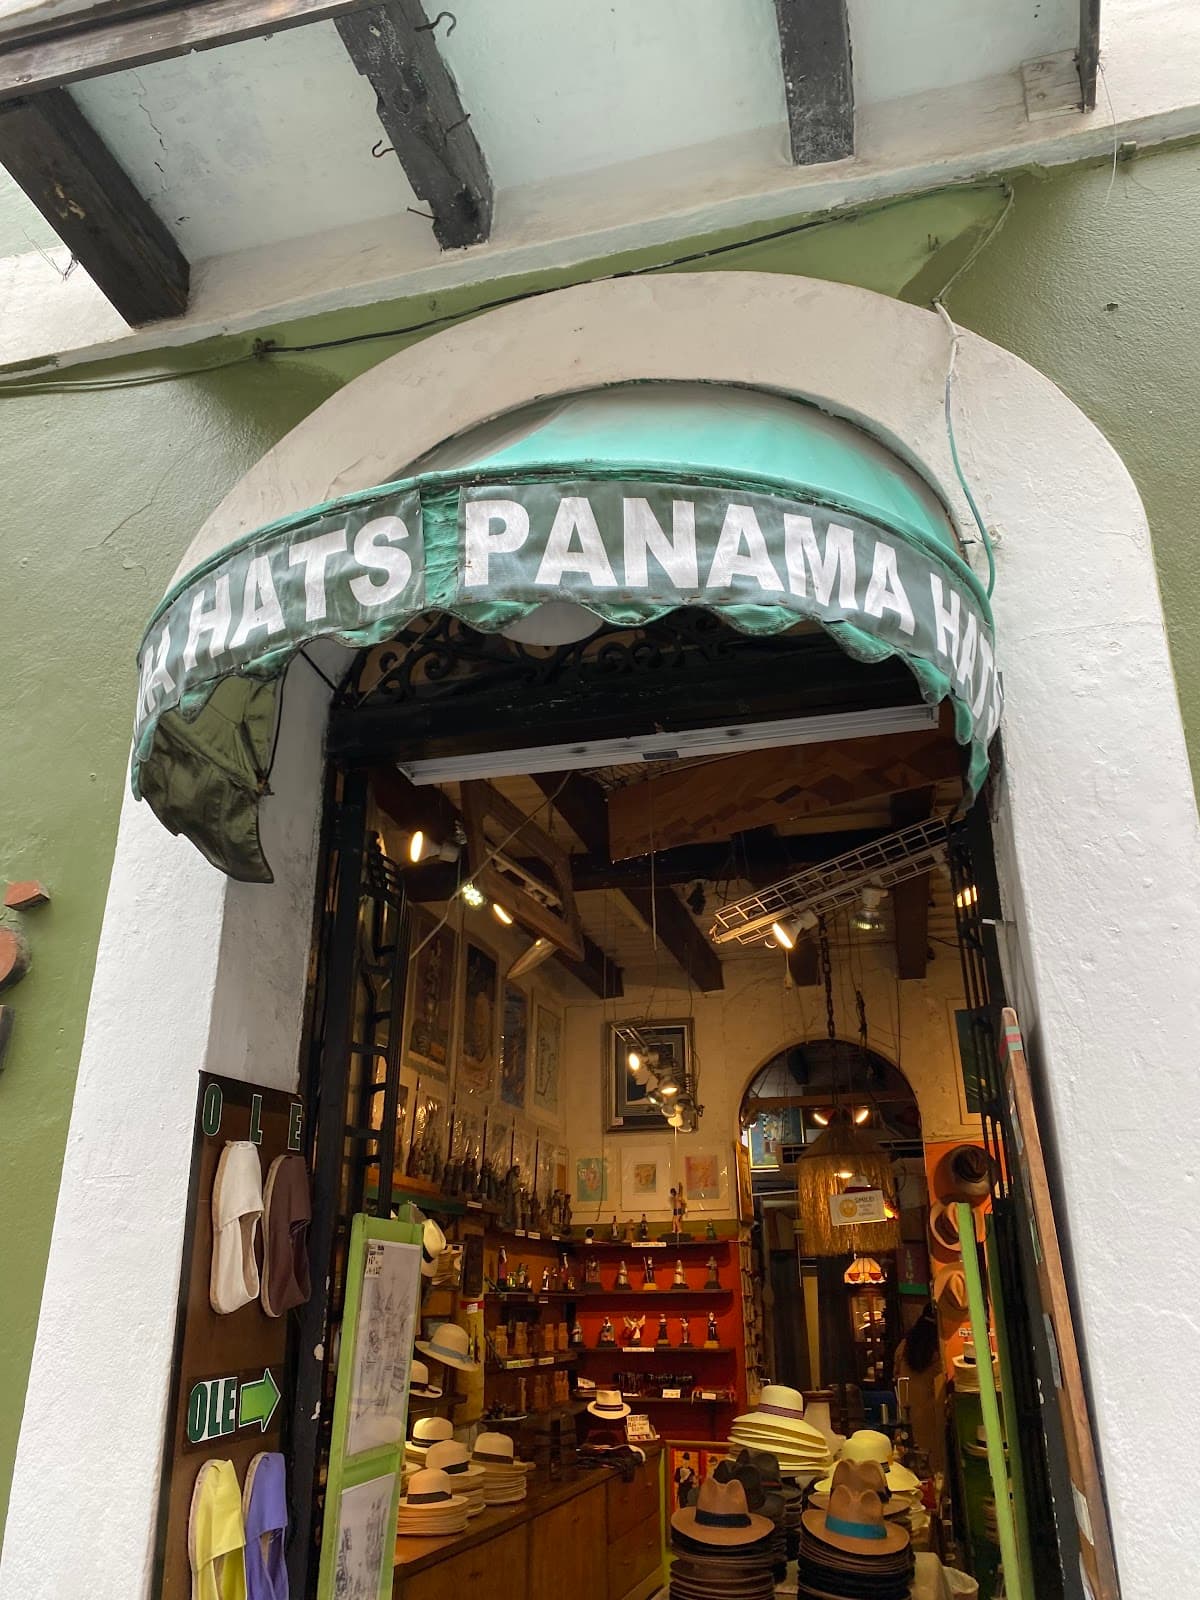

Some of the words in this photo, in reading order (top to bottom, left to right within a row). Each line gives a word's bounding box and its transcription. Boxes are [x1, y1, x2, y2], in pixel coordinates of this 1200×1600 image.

[183, 515, 413, 671] HATS
[463, 496, 916, 636] PANAMA
[187, 1376, 239, 1443] OLE
